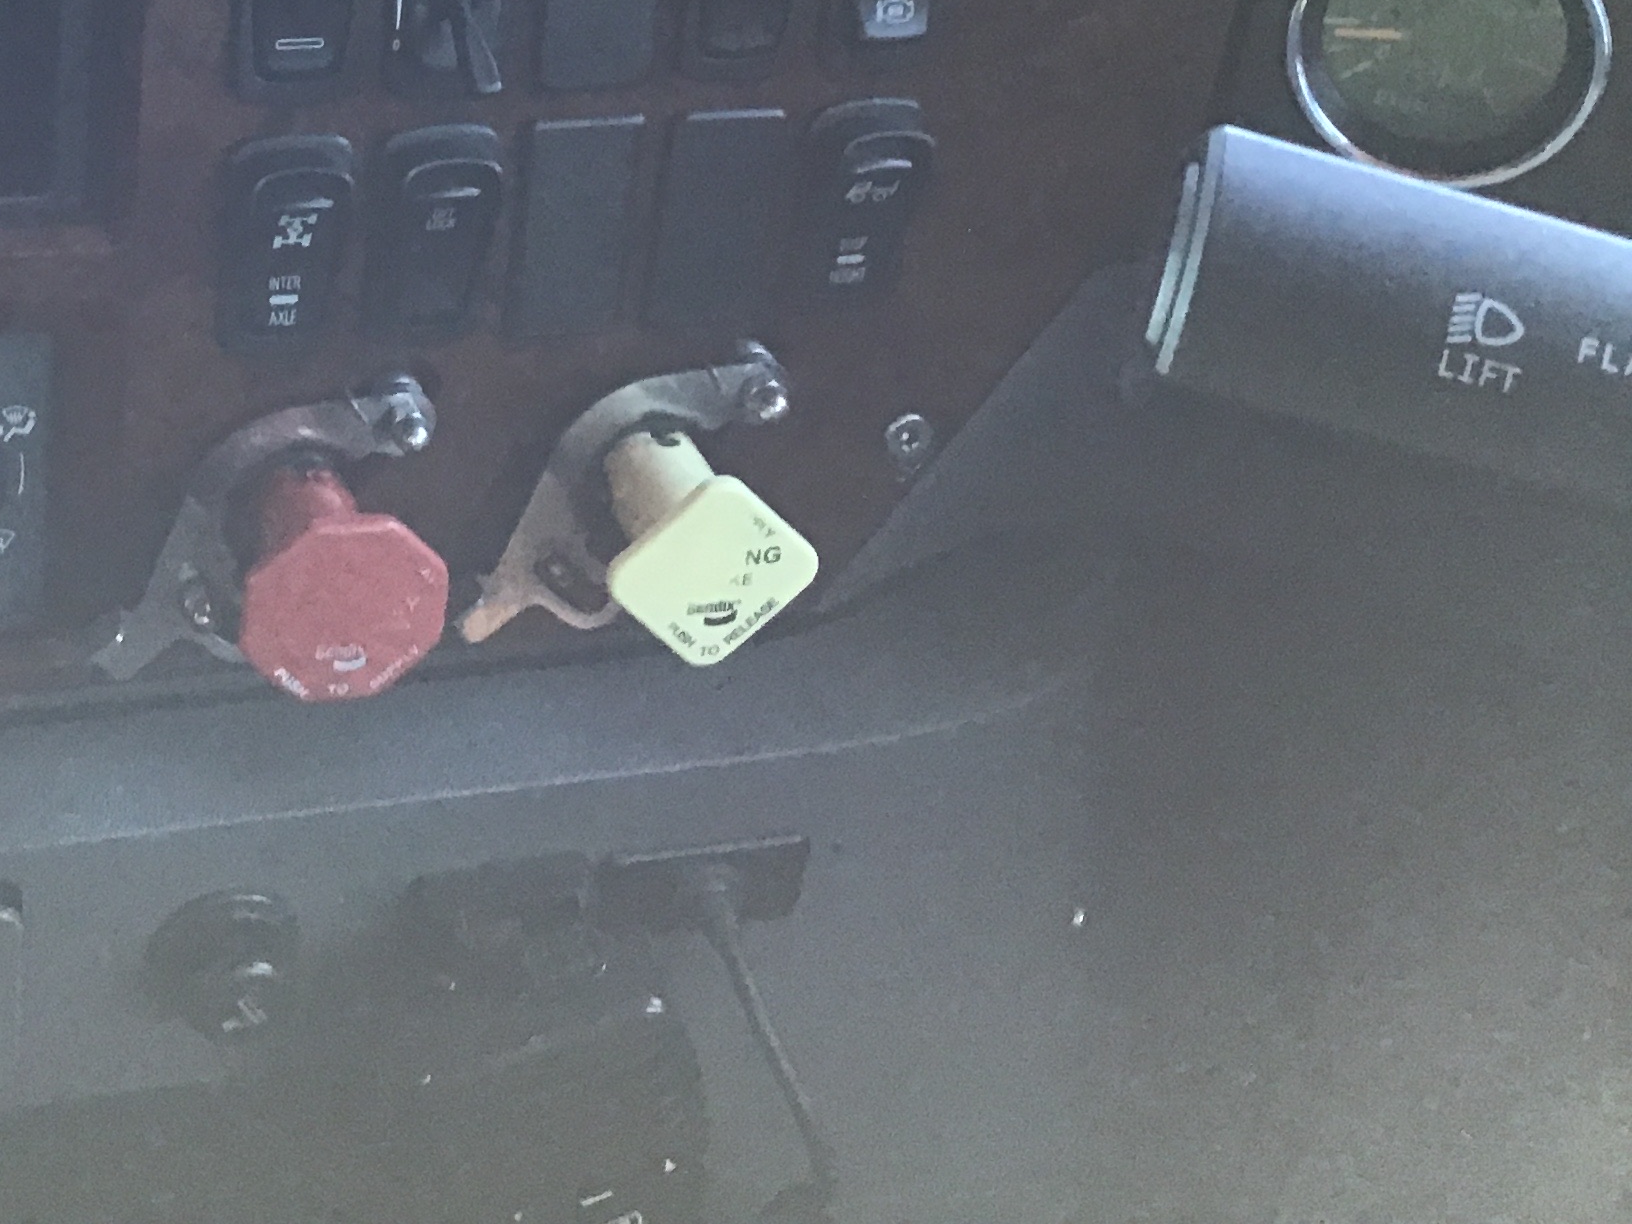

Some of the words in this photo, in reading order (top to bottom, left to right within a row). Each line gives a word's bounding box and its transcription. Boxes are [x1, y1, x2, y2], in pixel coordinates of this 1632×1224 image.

[268, 309, 298, 327] AXLE
[1438, 349, 1522, 393] LIFT
[700, 644, 720, 657] TO
